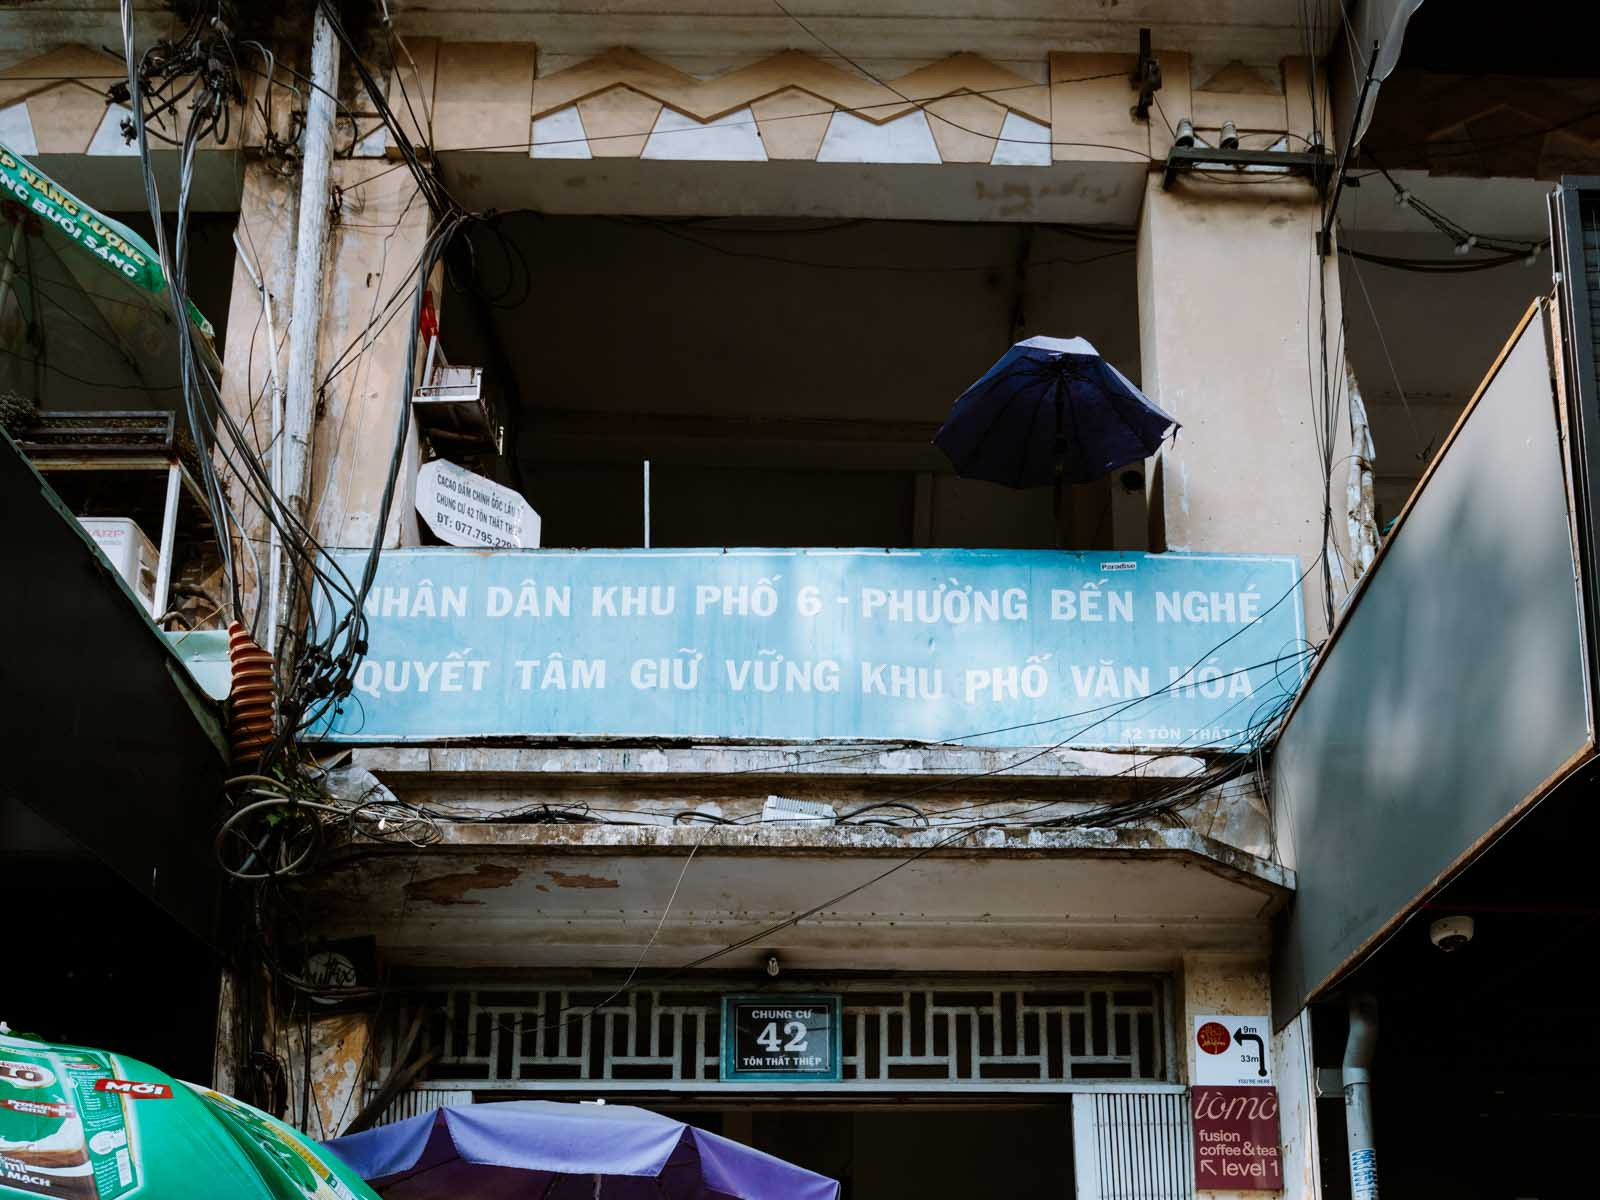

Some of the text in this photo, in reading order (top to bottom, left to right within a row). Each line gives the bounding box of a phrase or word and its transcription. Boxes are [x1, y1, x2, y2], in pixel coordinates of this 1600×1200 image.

[437, 474, 457, 492] CACAO
[436, 493, 456, 511] CHUNG
[466, 507, 475, 519] 42
[362, 575, 1263, 624] NHÂN DÂN KHU PHỐ 6 PHƯỜNG BẾN NGHÉ
[354, 647, 1255, 704] QUYẾT TÂM GIỮ VỮNG KHU PHỐ VĂN HÓA
[751, 1008, 814, 1019] CHUNG CƯ
[756, 1021, 808, 1052] 42
[1243, 1026, 1257, 1034] 9m
[743, 1054, 822, 1067] TÔN THẤT THIỆP
[1240, 1055, 1260, 1063] 33m
[1199, 1129, 1240, 1142] fusion
[1199, 1144, 1241, 1157] coffee
[1255, 1145, 1278, 1157] tea
[1222, 1158, 1279, 1177] level 1
[8, 1172, 51, 1187] MẠCH
